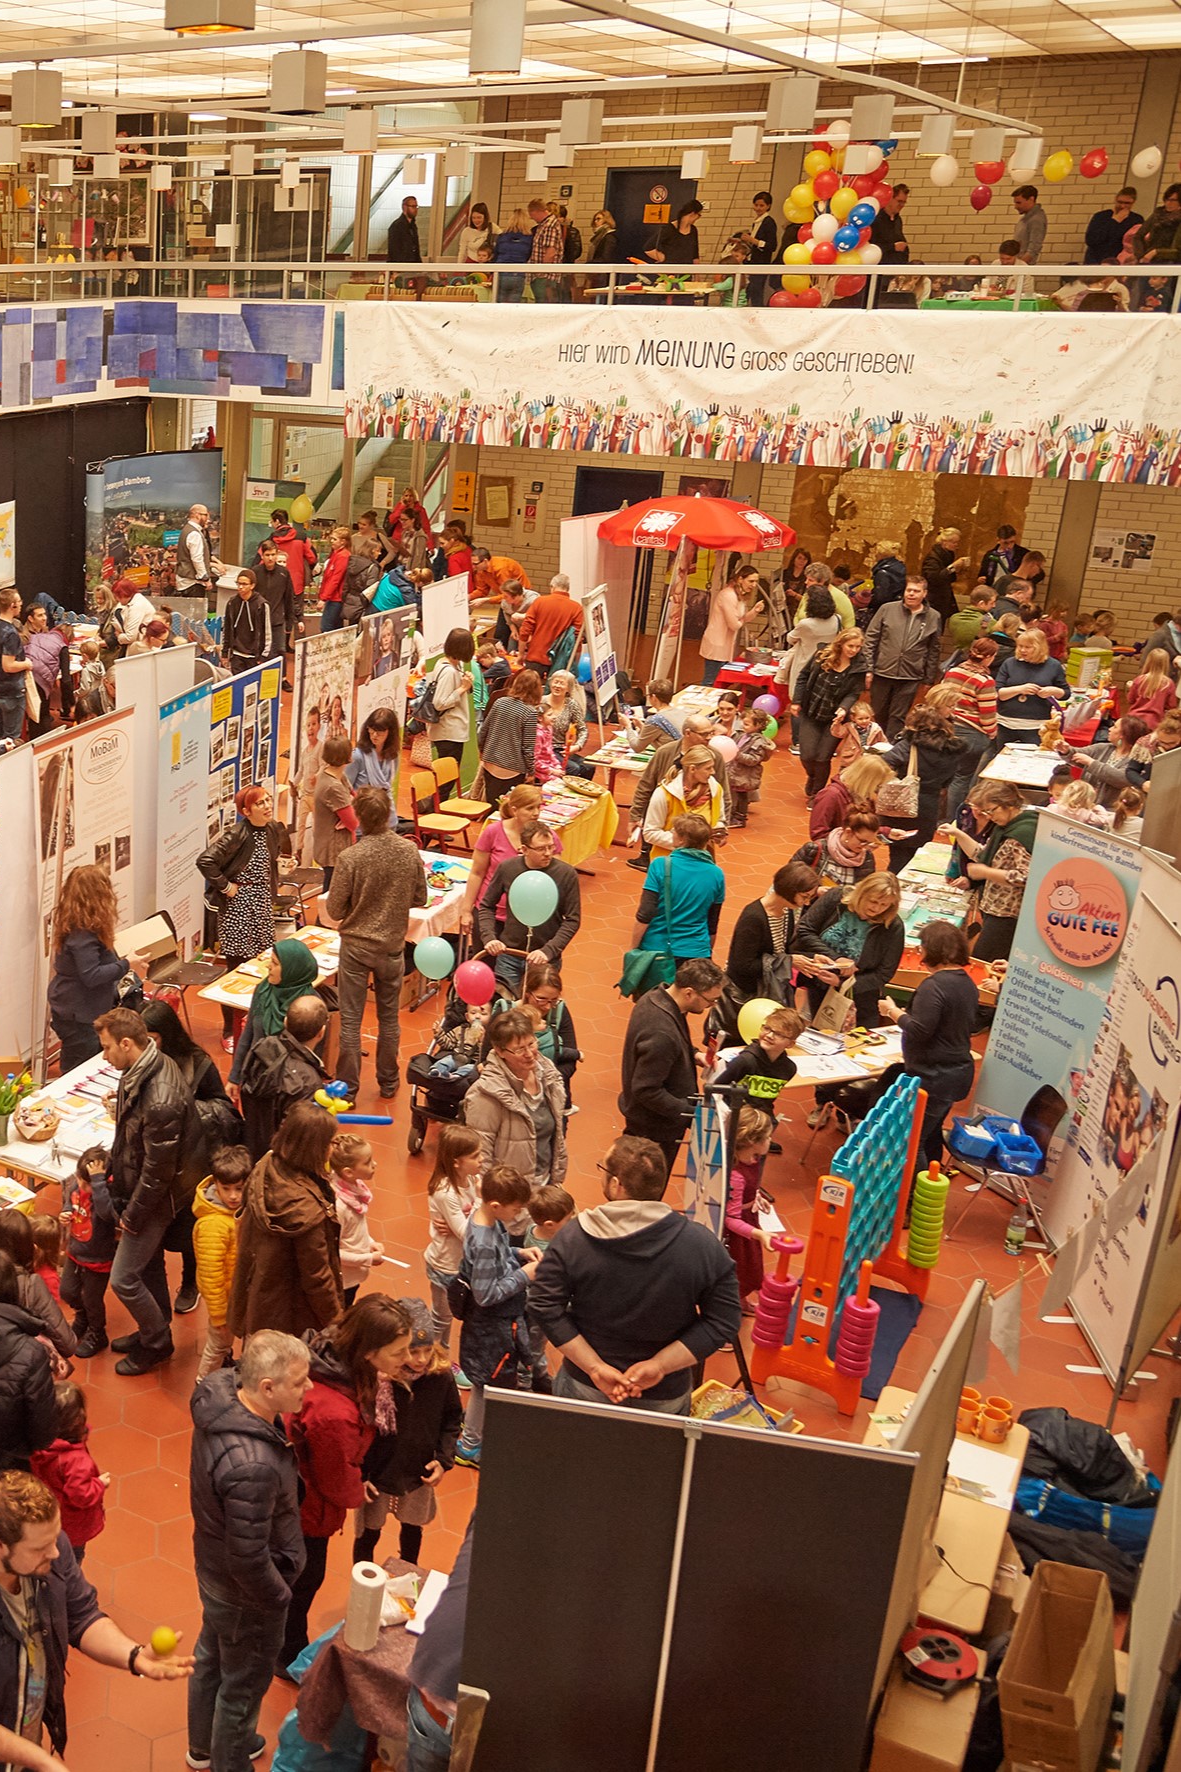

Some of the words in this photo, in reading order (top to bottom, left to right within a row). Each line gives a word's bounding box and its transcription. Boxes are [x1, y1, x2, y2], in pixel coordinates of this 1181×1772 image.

[636, 535, 664, 545] caritas
[90, 737, 119, 759] MoBaM
[1050, 829, 1114, 862] kinderfreundliches
[1115, 856, 1143, 873] Bamber
[1068, 827, 1109, 848] Gemeinsam
[1110, 843, 1121, 853] für
[1122, 848, 1134, 857] ein
[1047, 911, 1087, 932] GUTE
[1092, 919, 1120, 938] FEE
[1077, 902, 1121, 922] Aktion
[1043, 926, 1064, 954] Schnelle
[1092, 941, 1114, 958] Kinder
[1013, 964, 1034, 980] Hilfe
[1034, 974, 1051, 991] geht
[1051, 984, 1065, 996] vor
[1038, 960, 1086, 991] goldenen
[1010, 977, 1046, 1001] Offenheit
[1047, 992, 1061, 1005] bei
[1005, 998, 1044, 1022] Erweiterte
[1007, 988, 1028, 1001] allen
[1029, 996, 1086, 1031] Mitarbeitenden
[998, 1028, 1026, 1049] Telefon
[1000, 1018, 1030, 1039] Toilette
[1002, 1008, 1073, 1050] Notfall-Telefonliste
[993, 1049, 1043, 1082] Tür-Aufkleber
[995, 1039, 1016, 1054] Erste
[1016, 1048, 1034, 1065] Hilfe
